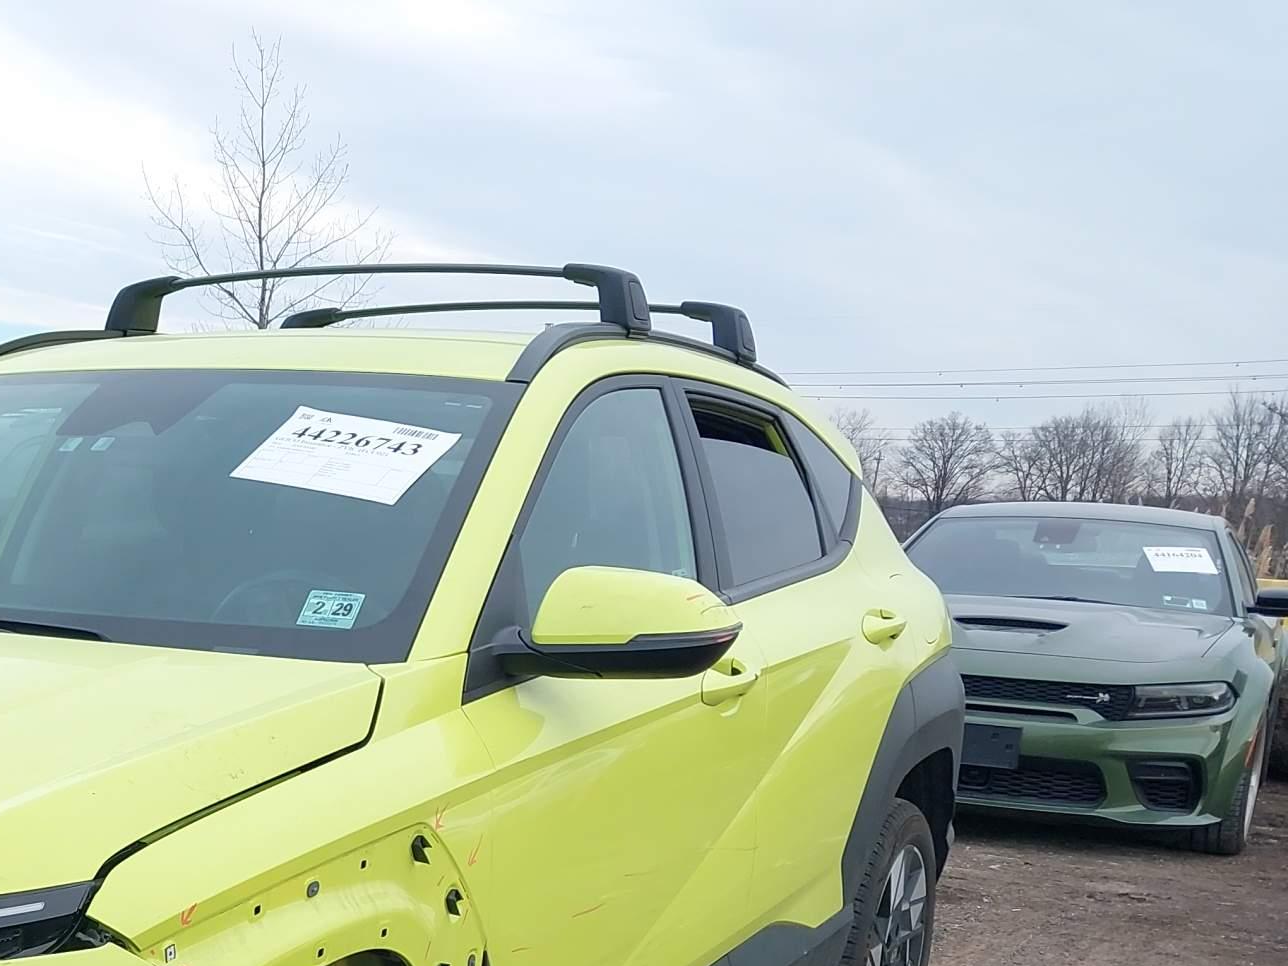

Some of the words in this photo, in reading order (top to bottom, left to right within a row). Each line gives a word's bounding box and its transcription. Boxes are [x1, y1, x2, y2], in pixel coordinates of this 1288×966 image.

[291, 426, 423, 456] 44226743
[312, 601, 326, 615] 2
[331, 603, 353, 617] 29
